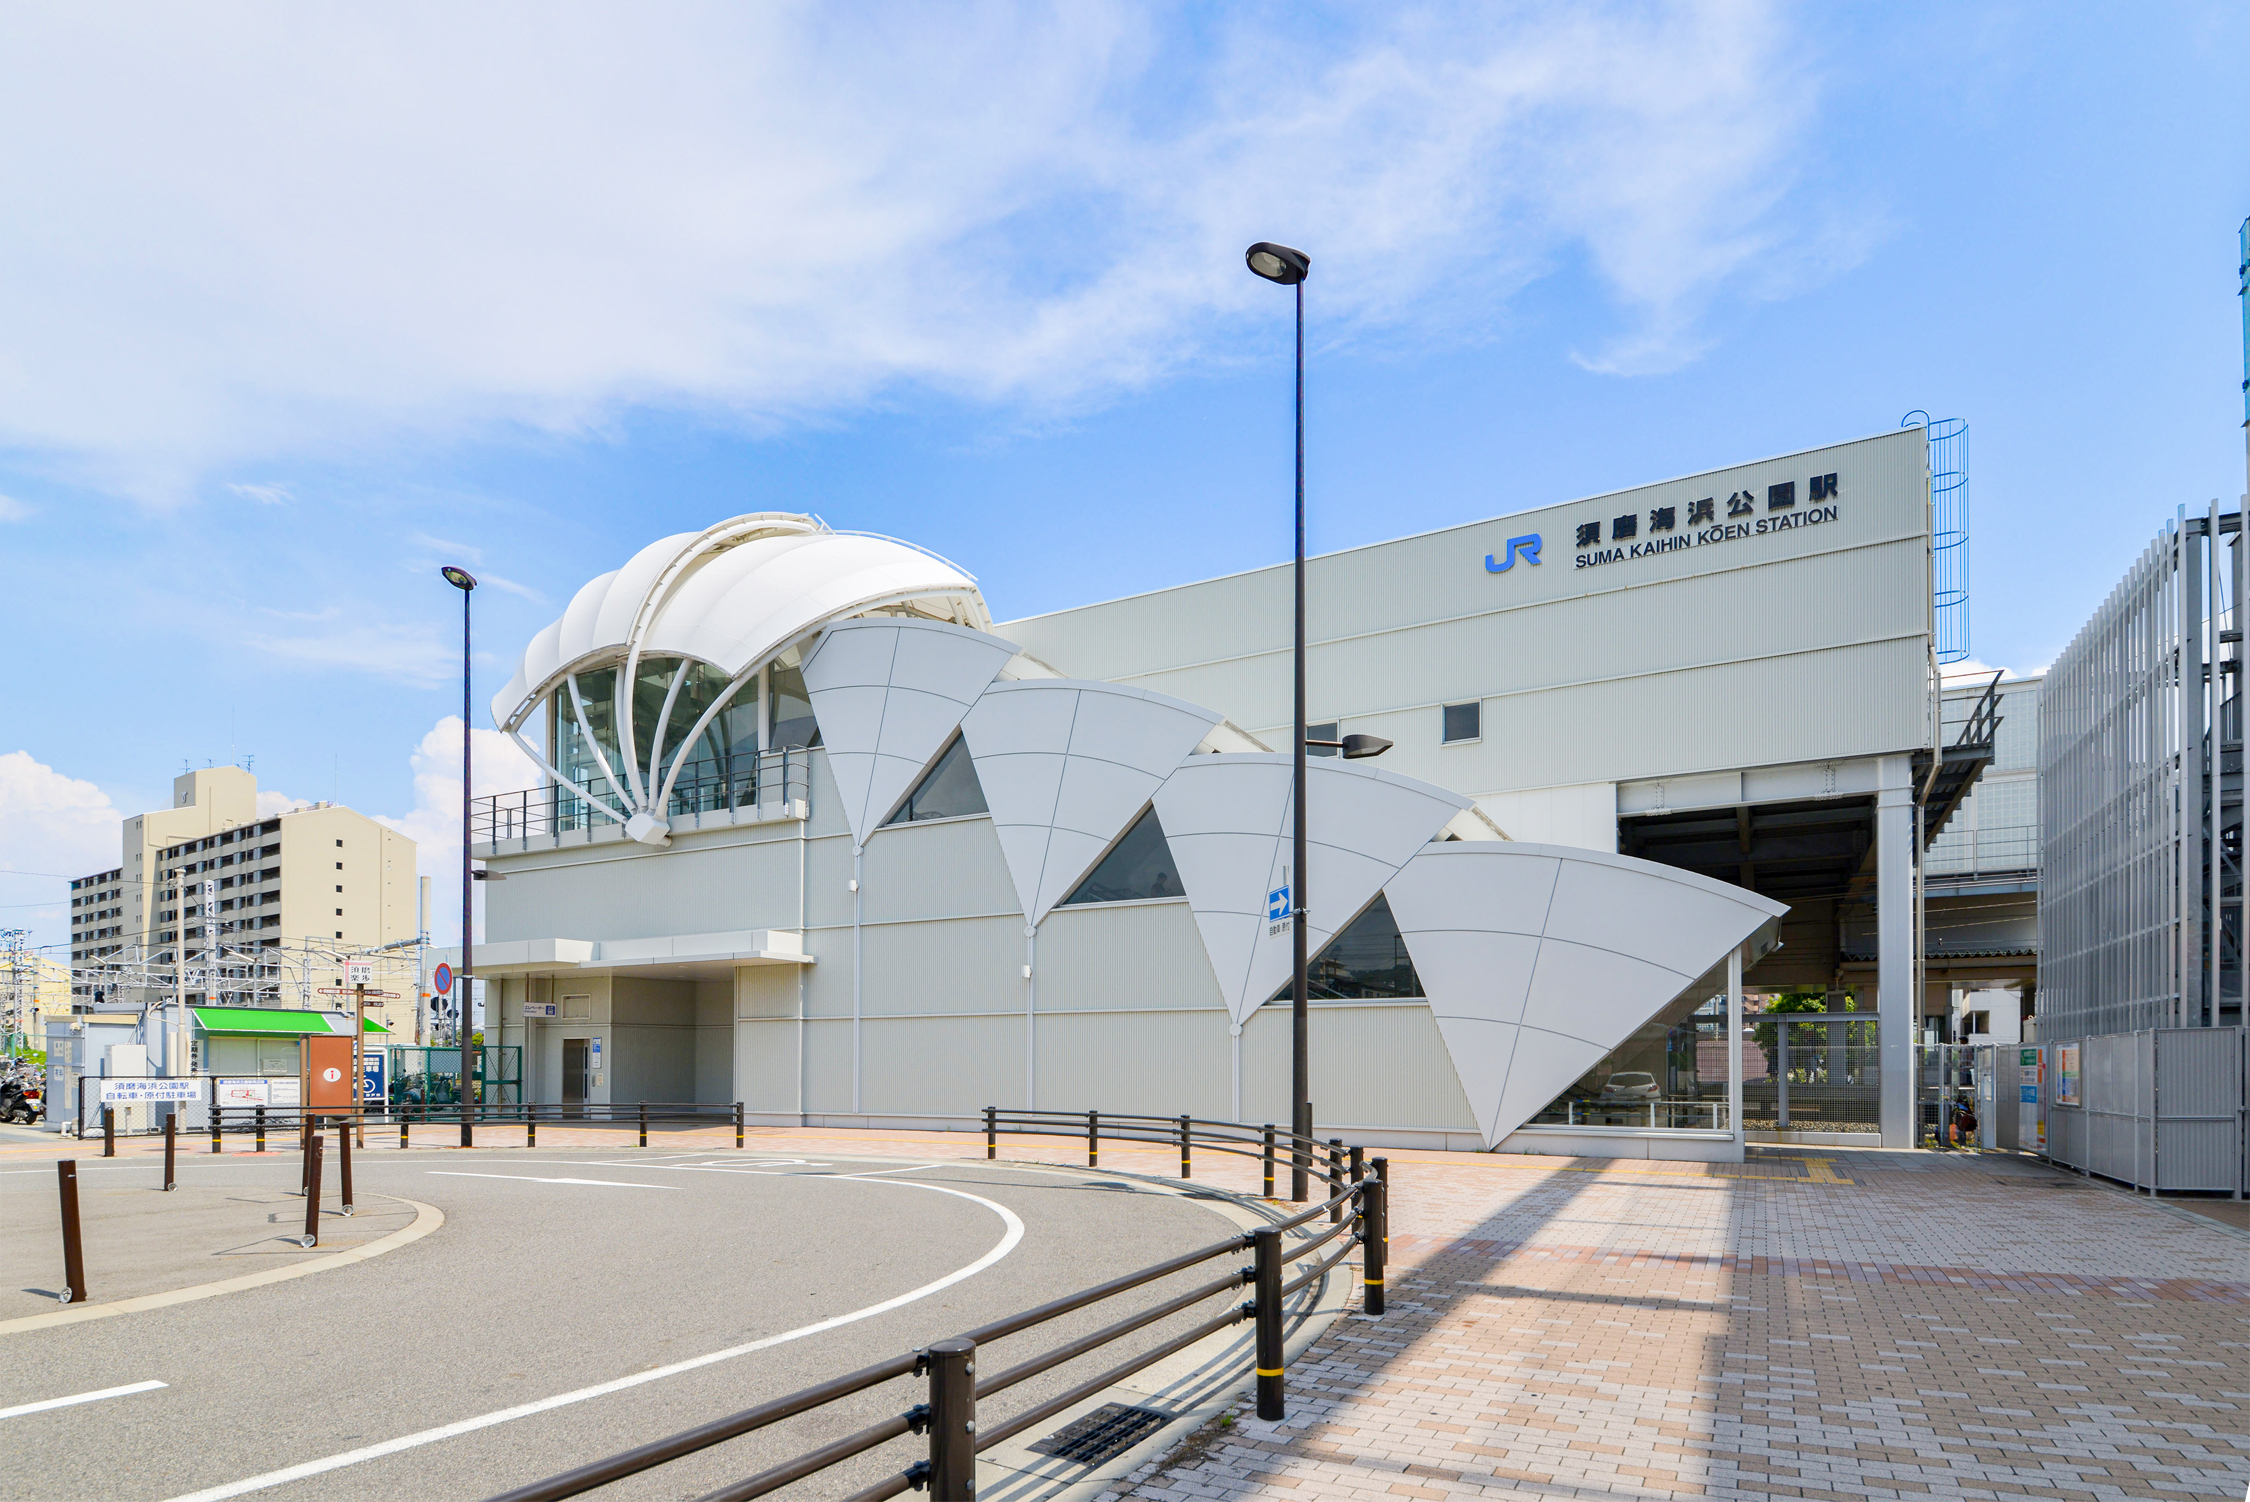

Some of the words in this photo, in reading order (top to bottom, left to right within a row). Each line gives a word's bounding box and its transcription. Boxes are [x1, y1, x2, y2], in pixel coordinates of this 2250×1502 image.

[1575, 472, 1840, 549] 須磨海浜公園駅
[1485, 533, 1543, 573] JR
[1575, 550, 1625, 568] SUMA
[1630, 534, 1691, 558] KAIHIN
[1755, 505, 1838, 534] STATION
[105, 1091, 197, 1100] 自転車・原付駐車場
[114, 1082, 190, 1090] 須磨海浜公園駅
